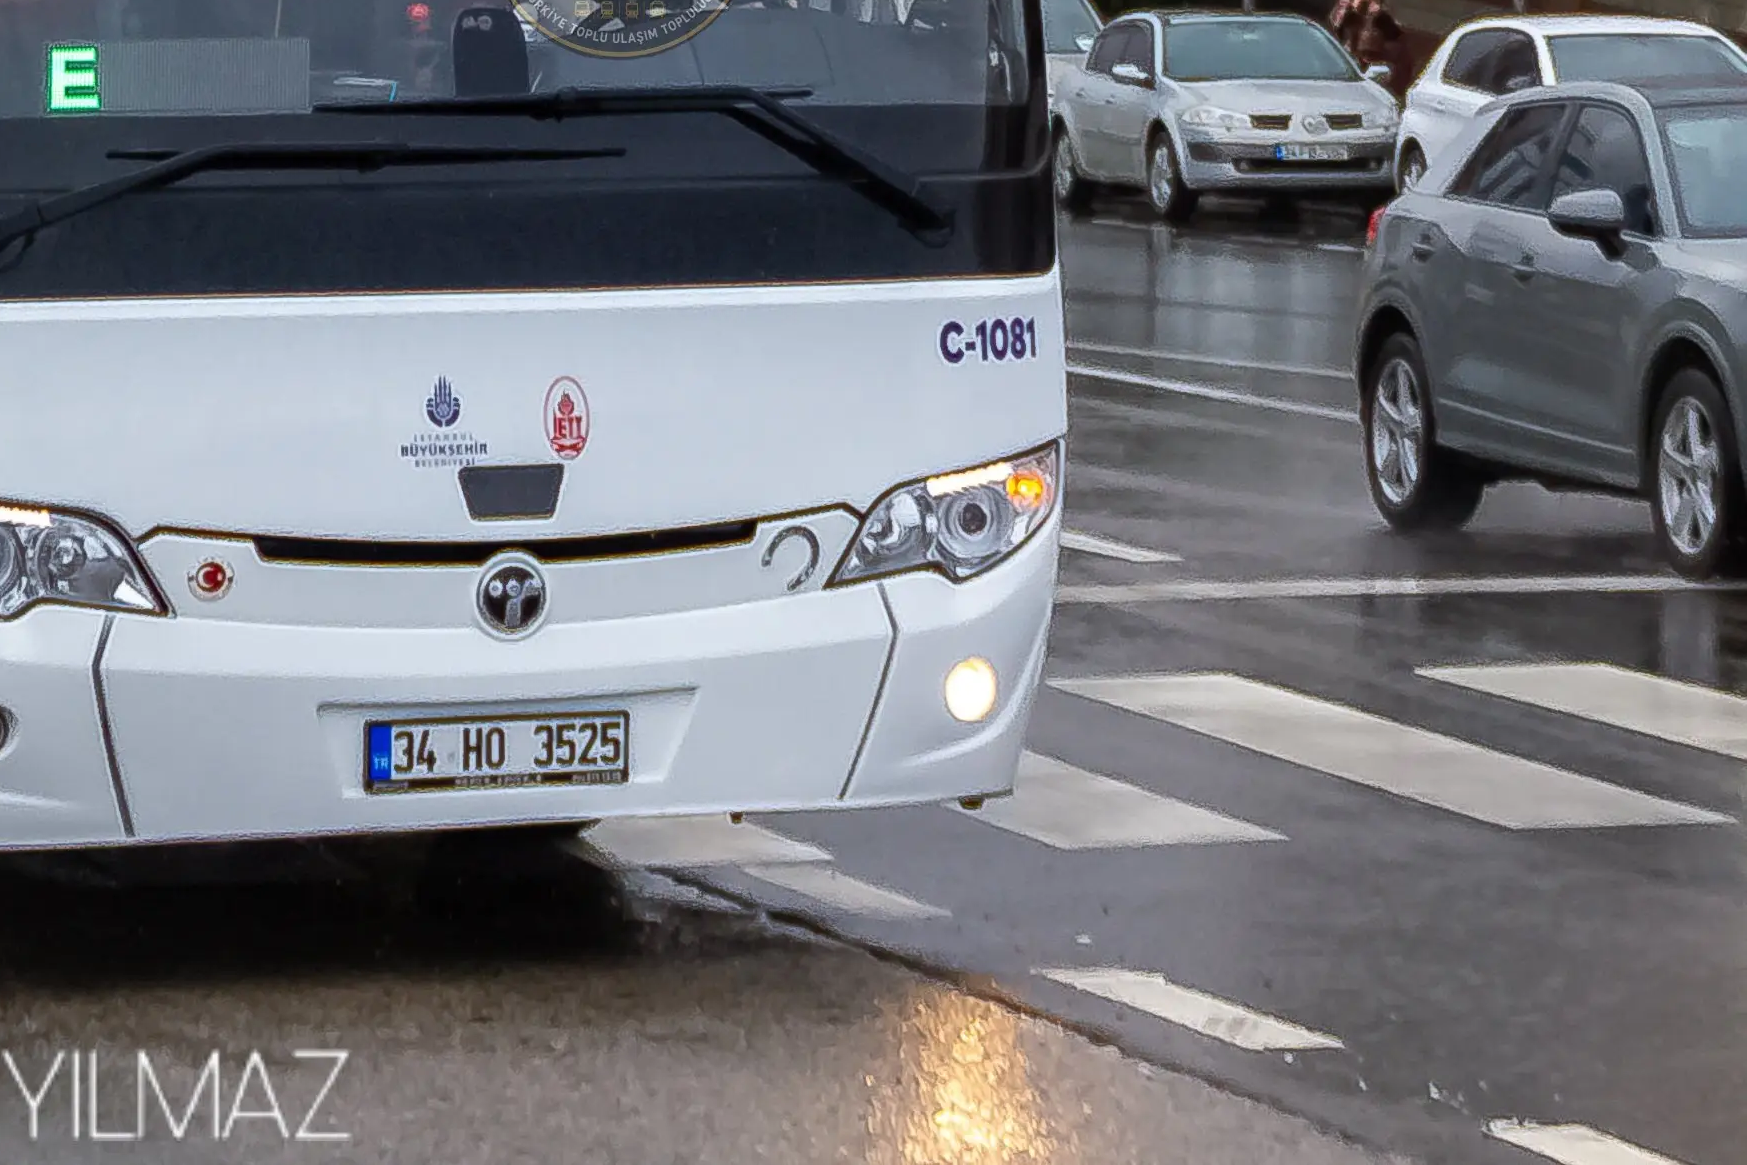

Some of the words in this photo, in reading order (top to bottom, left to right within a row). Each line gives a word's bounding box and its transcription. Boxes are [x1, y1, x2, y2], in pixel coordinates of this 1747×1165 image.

[50, 46, 101, 110] E
[939, 316, 1037, 364] C-1081
[393, 729, 437, 774] 34
[462, 727, 506, 771] HO
[534, 722, 621, 767] 3525
